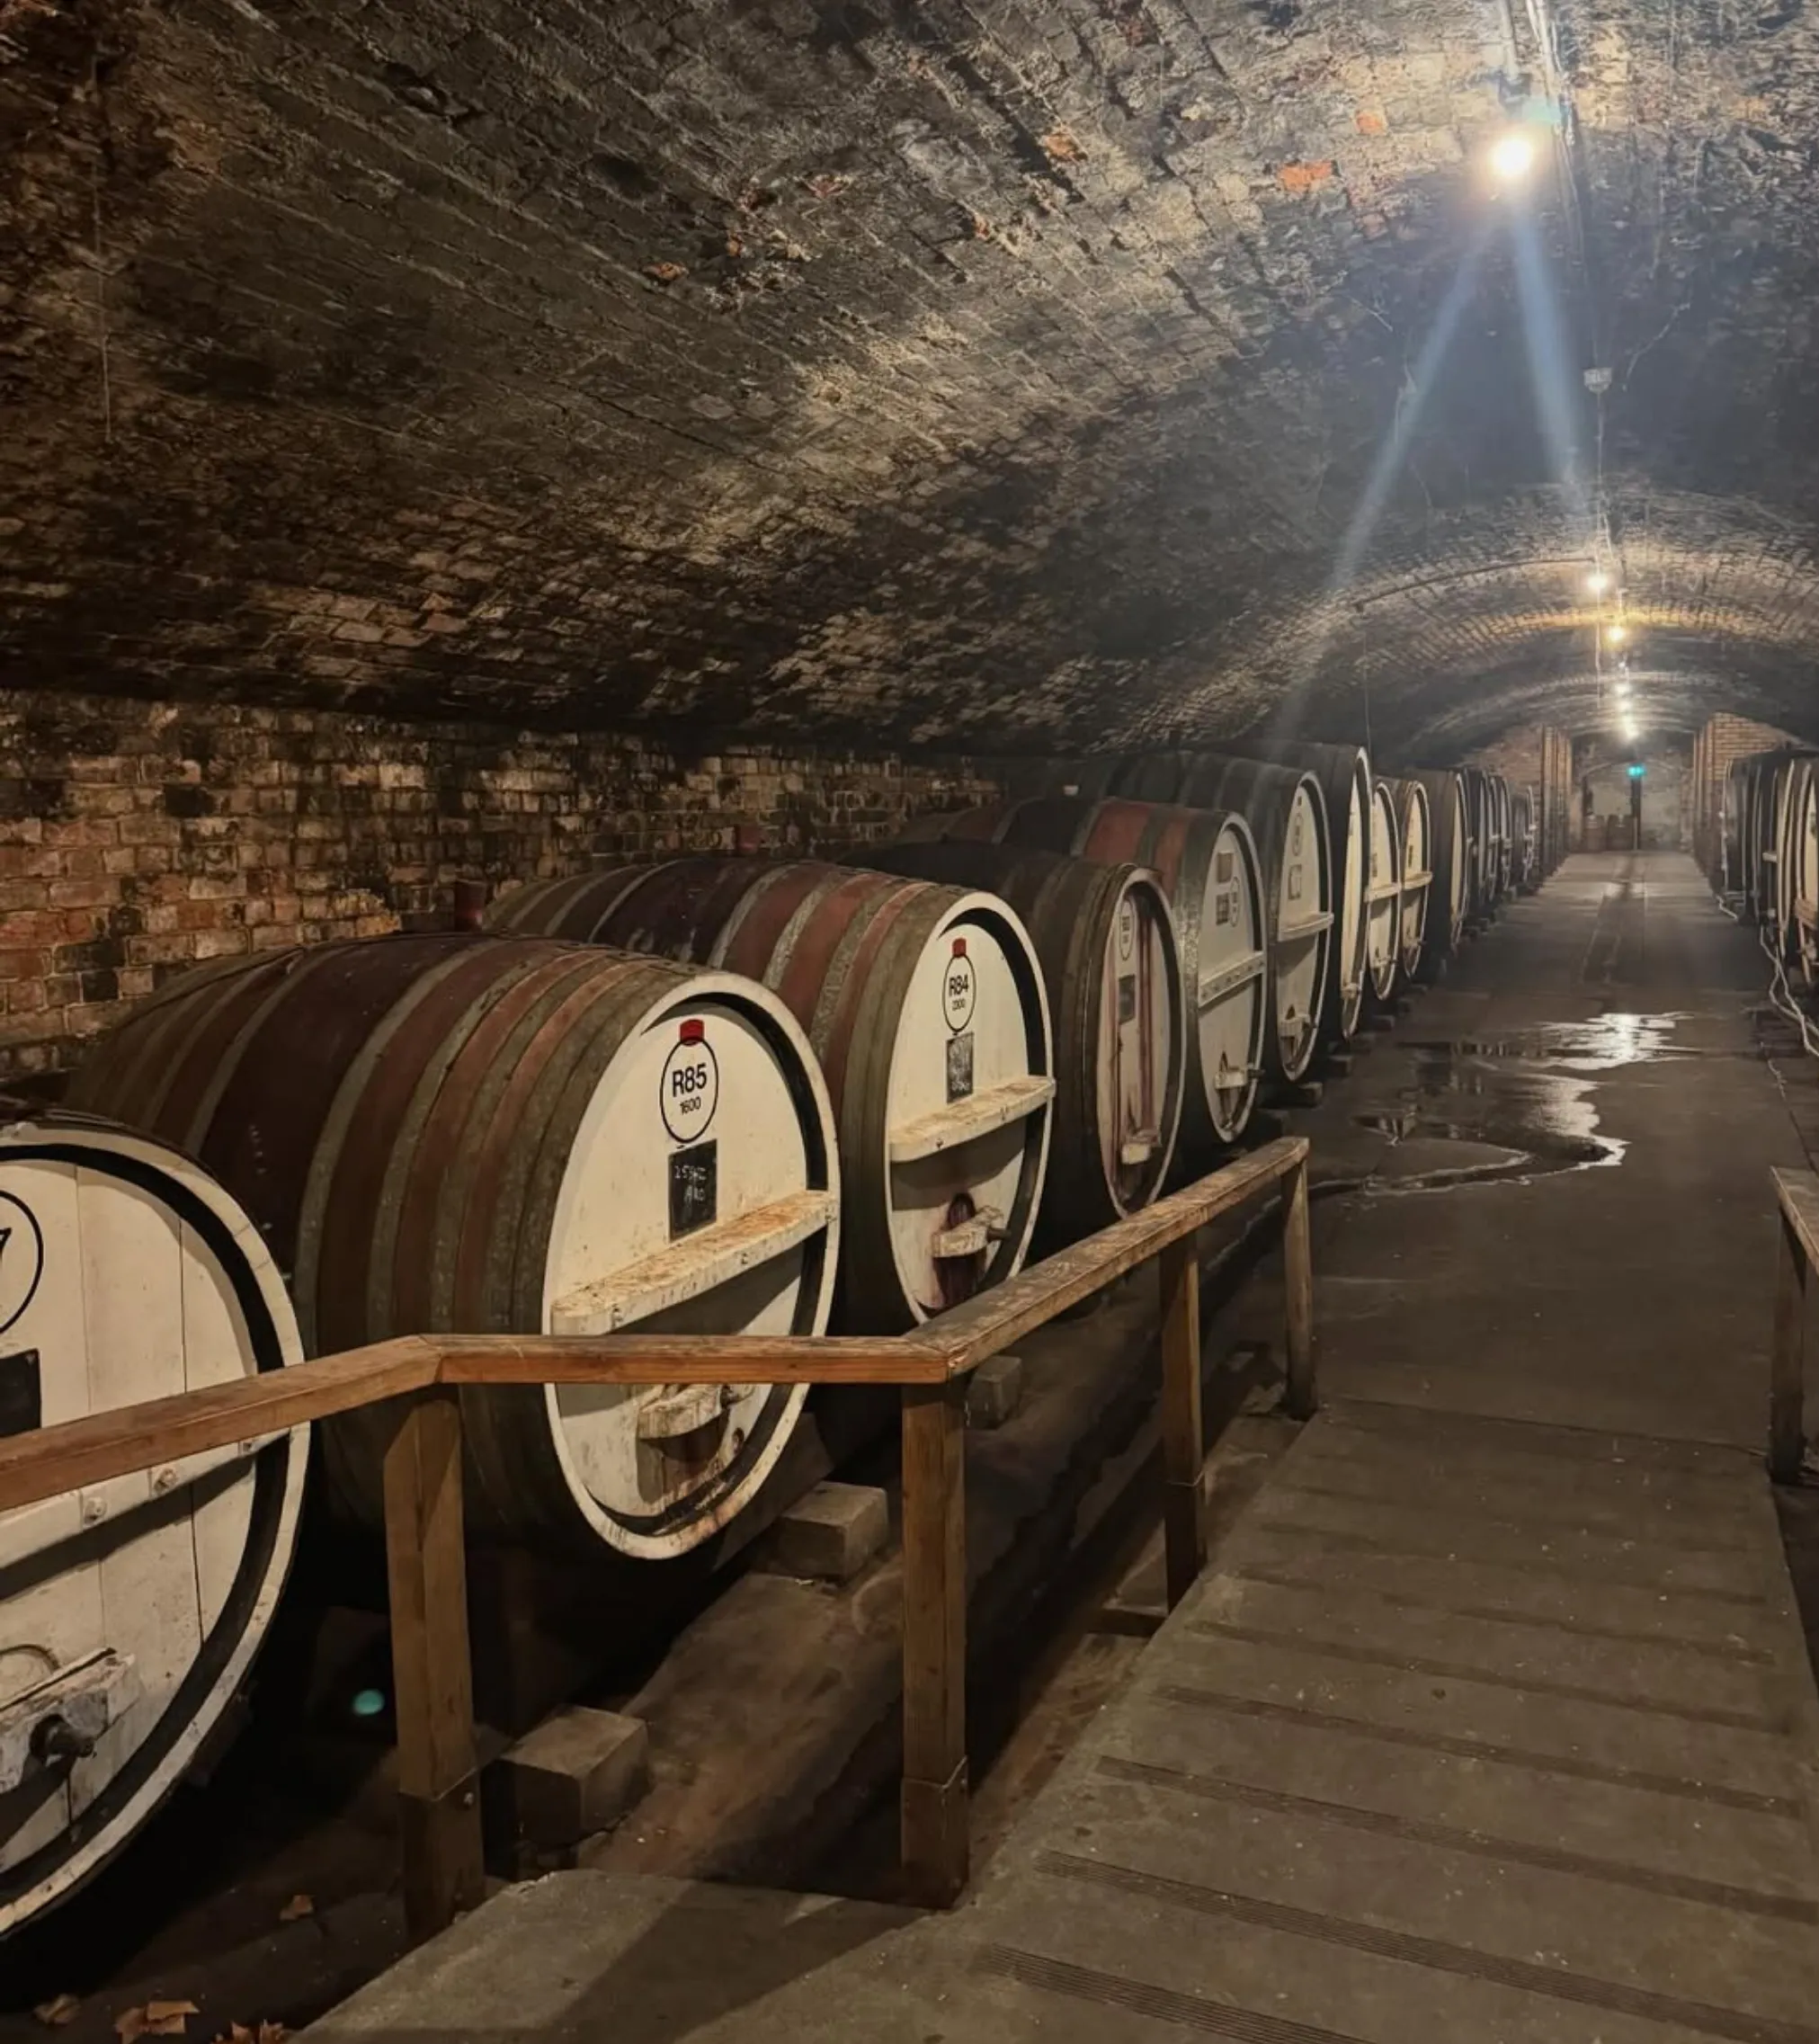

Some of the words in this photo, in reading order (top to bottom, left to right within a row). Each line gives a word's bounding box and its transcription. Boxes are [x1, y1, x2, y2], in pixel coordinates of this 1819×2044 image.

[949, 974, 968, 996] R84
[673, 1063, 707, 1097] R85
[680, 1096, 701, 1115] 1600
